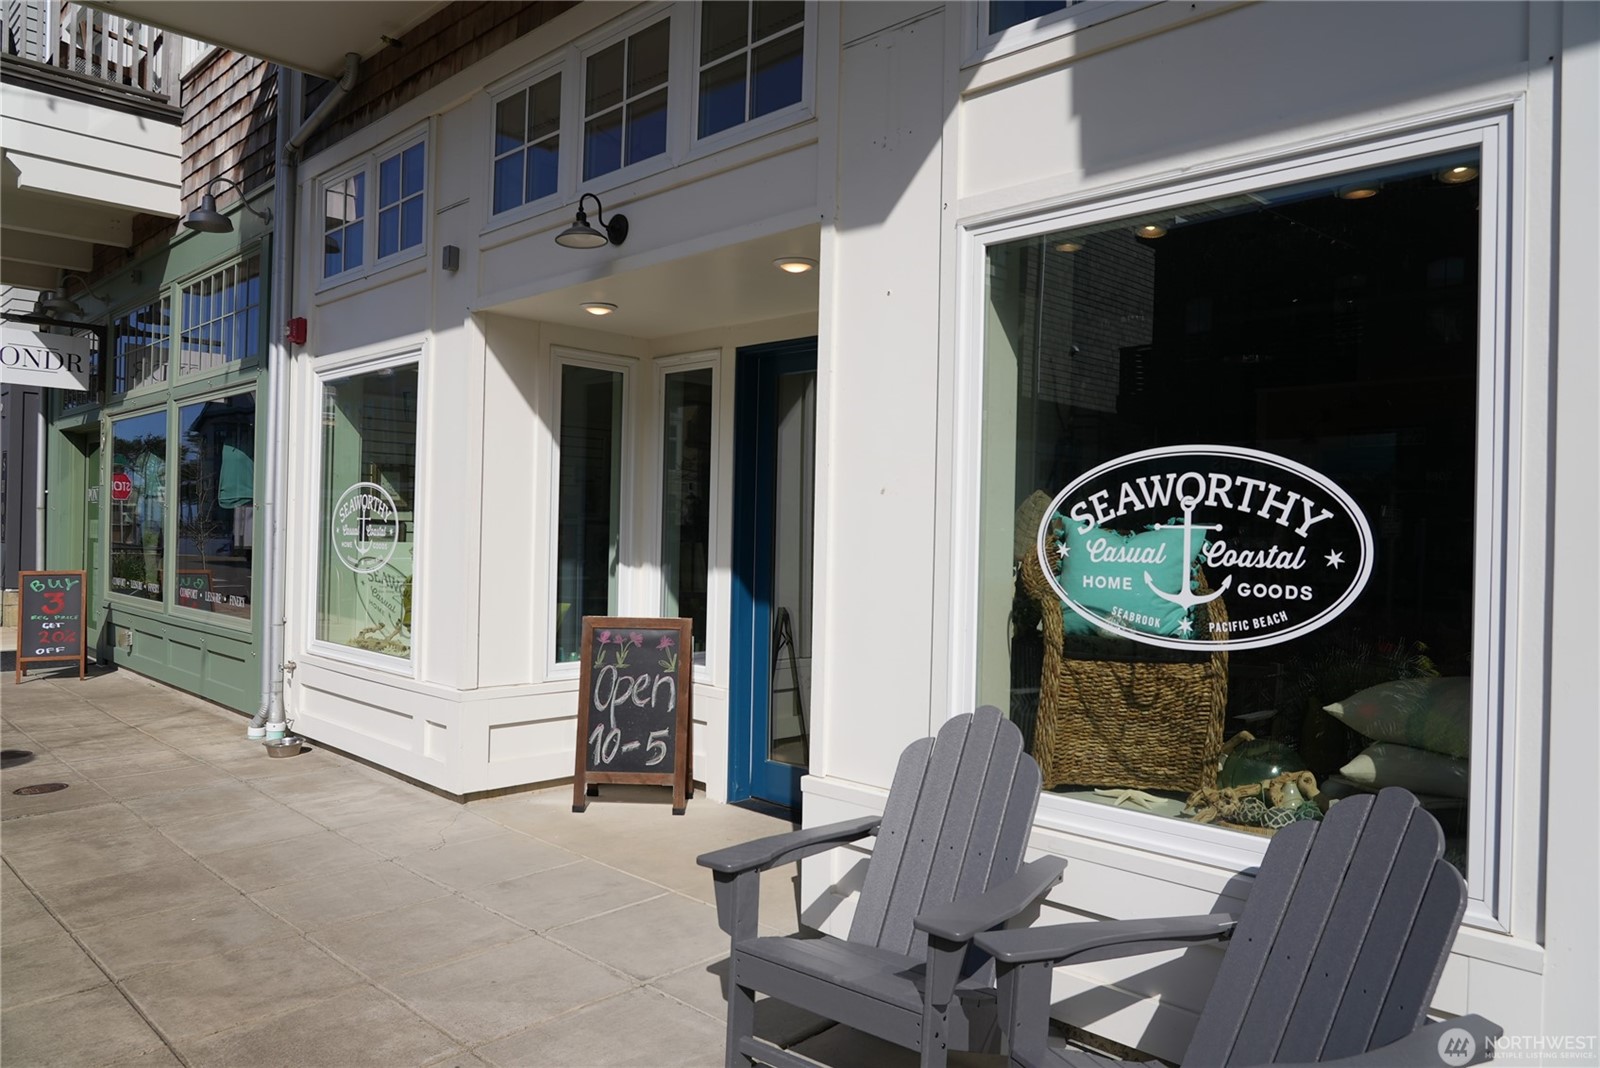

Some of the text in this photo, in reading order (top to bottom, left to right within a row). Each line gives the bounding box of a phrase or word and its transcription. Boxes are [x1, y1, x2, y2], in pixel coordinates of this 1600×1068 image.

[339, 494, 392, 523] SEAWORTHY
[1070, 472, 1333, 537] SEAWORTHY
[1086, 538, 1306, 570] Casual Coastal
[30, 578, 79, 592] BUY
[1082, 575, 1313, 601] HOME GOODS
[42, 592, 65, 615] 3
[1111, 606, 1288, 633] SEABROOK PACIFIC BEACH
[37, 629, 76, 643] 20%
[35, 646, 65, 655] OFF
[593, 665, 676, 729] Open
